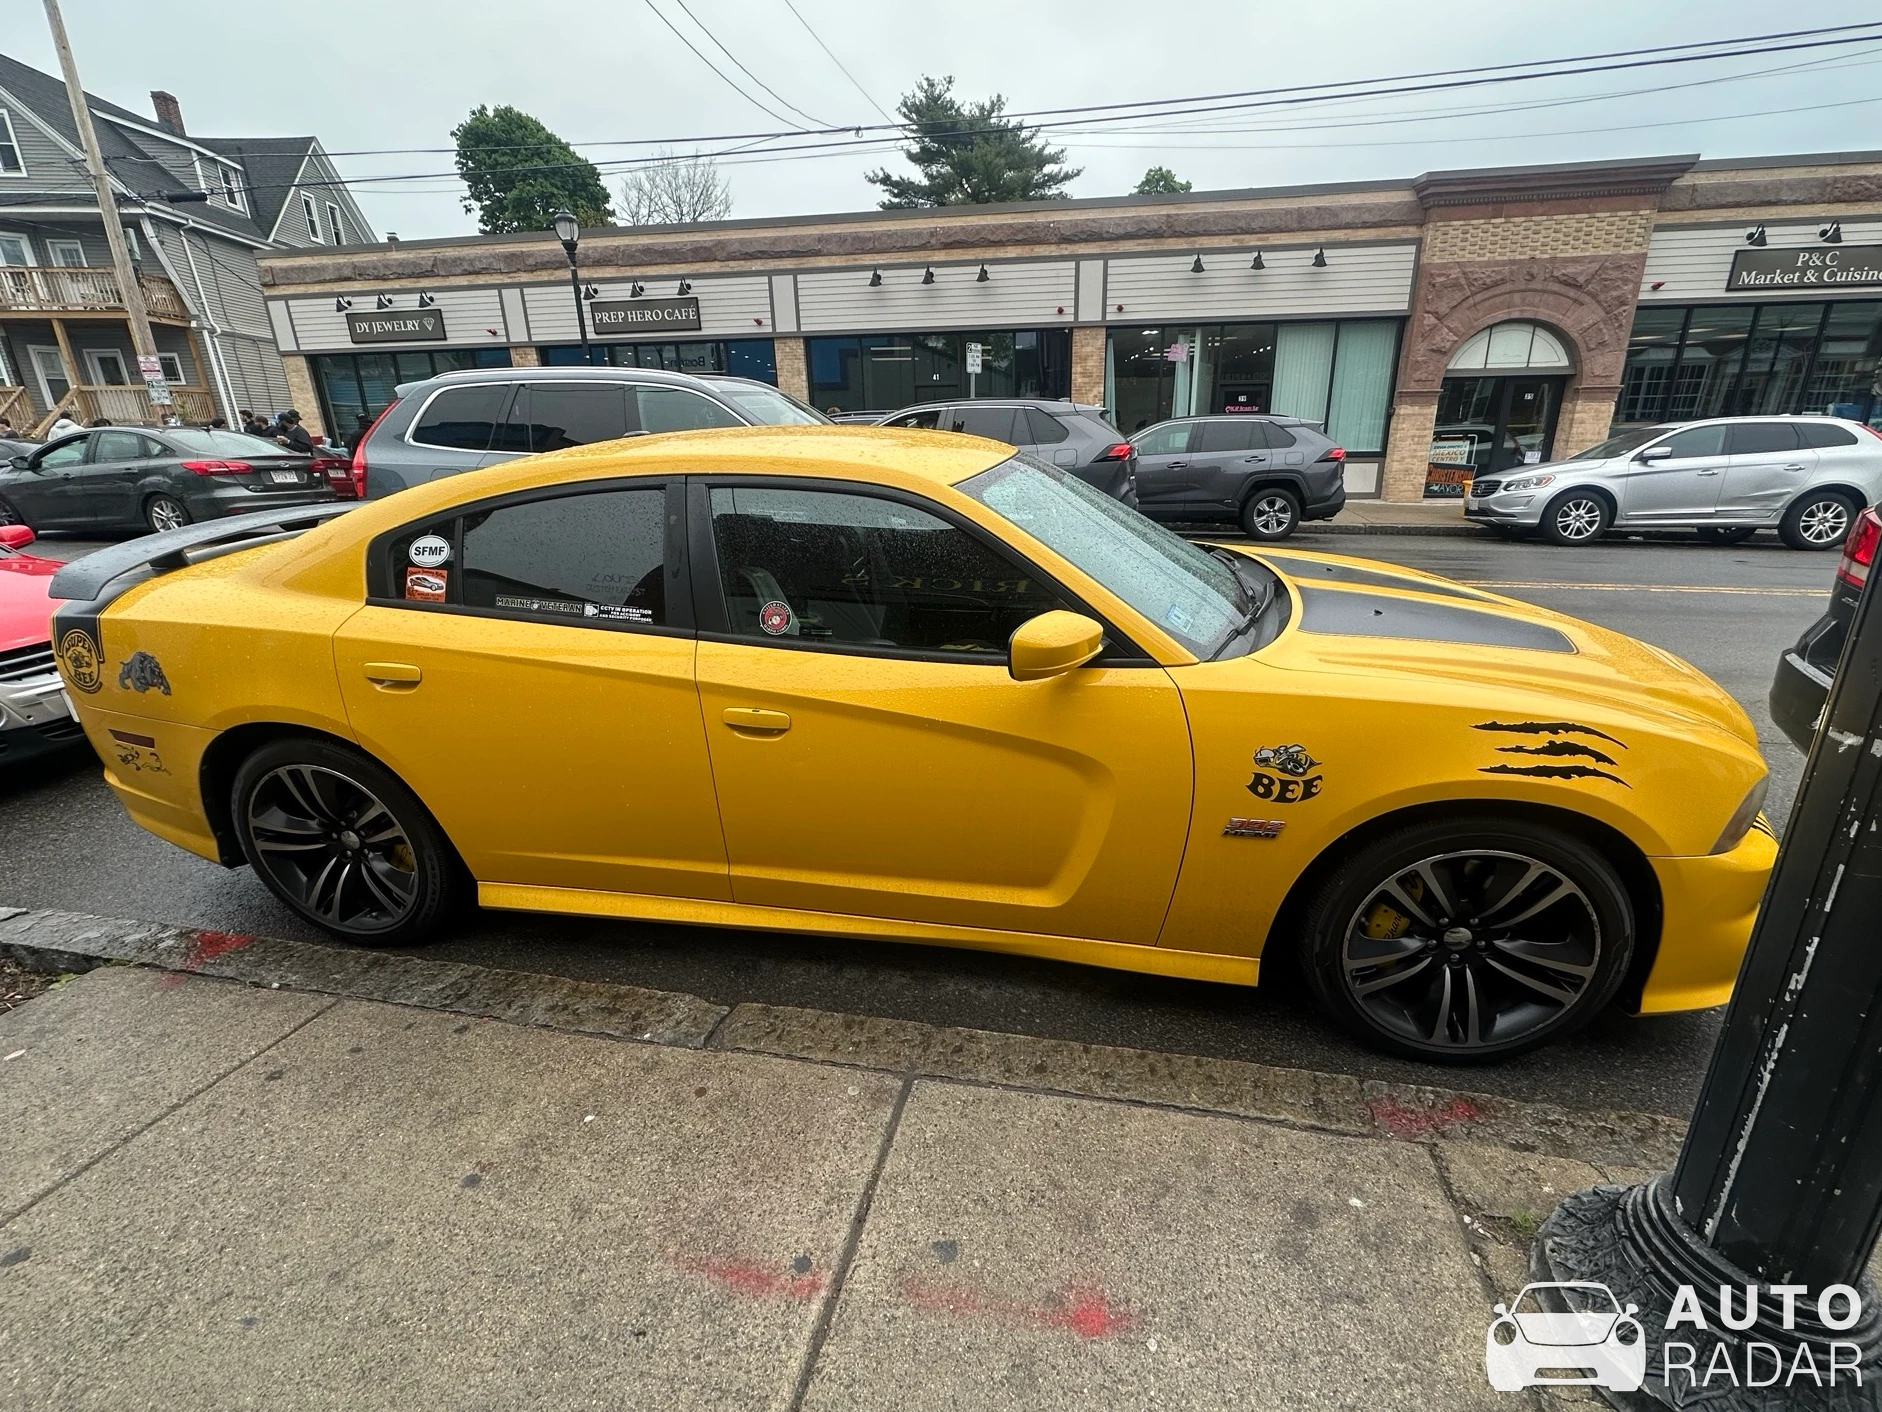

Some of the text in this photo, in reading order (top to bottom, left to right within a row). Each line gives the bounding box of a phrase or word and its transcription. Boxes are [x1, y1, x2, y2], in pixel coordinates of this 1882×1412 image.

[1796, 251, 1840, 267] P&C
[1738, 269, 1801, 285] Market
[1803, 269, 1820, 283] &
[594, 304, 697, 323] PREP HERO CAFÉ
[355, 319, 420, 335] DY JEWELRY
[932, 373, 940, 381] 41
[413, 546, 446, 556] SFMF
[496, 596, 583, 613] MARINE VETERAN
[621, 607, 652, 615] OPERATION
[65, 634, 93, 658] SUPER
[74, 668, 95, 685] BEE
[1245, 771, 1323, 804] BEE
[1225, 817, 1286, 831] 392
